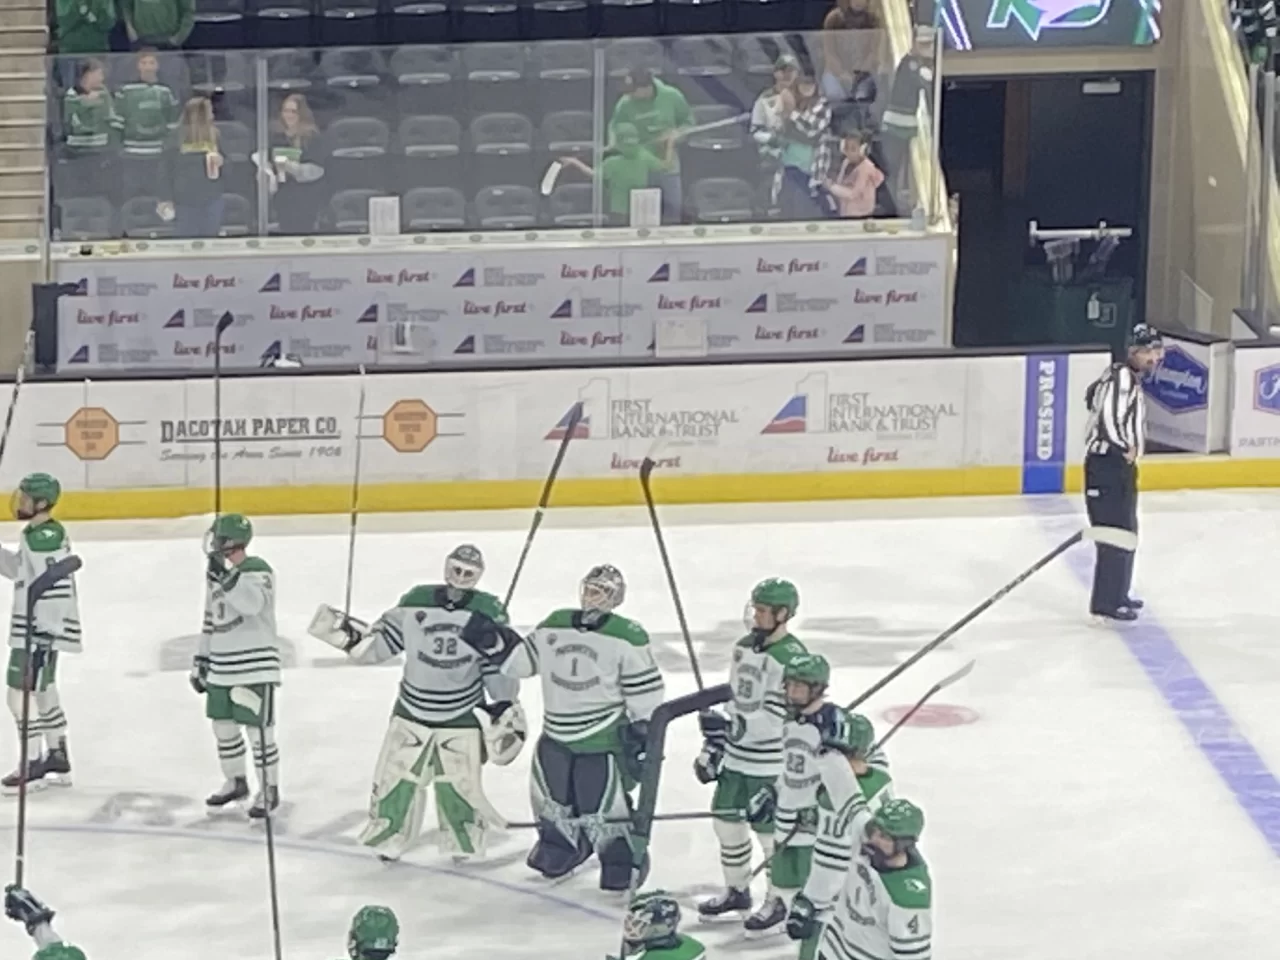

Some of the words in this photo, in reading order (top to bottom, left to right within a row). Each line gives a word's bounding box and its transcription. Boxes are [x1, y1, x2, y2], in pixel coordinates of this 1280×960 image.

[561, 264, 588, 279] live
[592, 265, 624, 281] first
[757, 258, 784, 273] live
[789, 259, 820, 275] first
[173, 273, 200, 289] live
[203, 274, 235, 291] first
[366, 268, 393, 284] live
[397, 269, 430, 286] first
[658, 294, 685, 309] live
[689, 295, 721, 312] first
[854, 288, 881, 304] live
[886, 289, 918, 306] first
[77, 309, 104, 324] live
[108, 310, 140, 327] first
[270, 304, 297, 320] live
[301, 305, 332, 322] first
[464, 300, 490, 315] live
[495, 301, 526, 318] first
[560, 331, 587, 346] live
[591, 331, 623, 348] first
[755, 326, 782, 341] live
[786, 326, 818, 343] first
[174, 341, 201, 355] live
[611, 399, 652, 411] FIRST
[830, 392, 870, 405] FIRST
[611, 410, 739, 425] INTERNATIONAL
[830, 403, 957, 418] INTERNATIONAL
[1036, 360, 1055, 461] PROSEED
[160, 418, 246, 443] DACOTAH
[252, 417, 310, 436] PAPER
[611, 424, 658, 439] BANK
[674, 423, 721, 437] TRUST
[830, 417, 873, 432] BANK
[876, 418, 889, 432] &
[892, 416, 939, 431] TRUST
[827, 446, 859, 463] live
[862, 446, 898, 465] first
[433, 637, 457, 656] 32
[907, 914, 918, 934] 4
